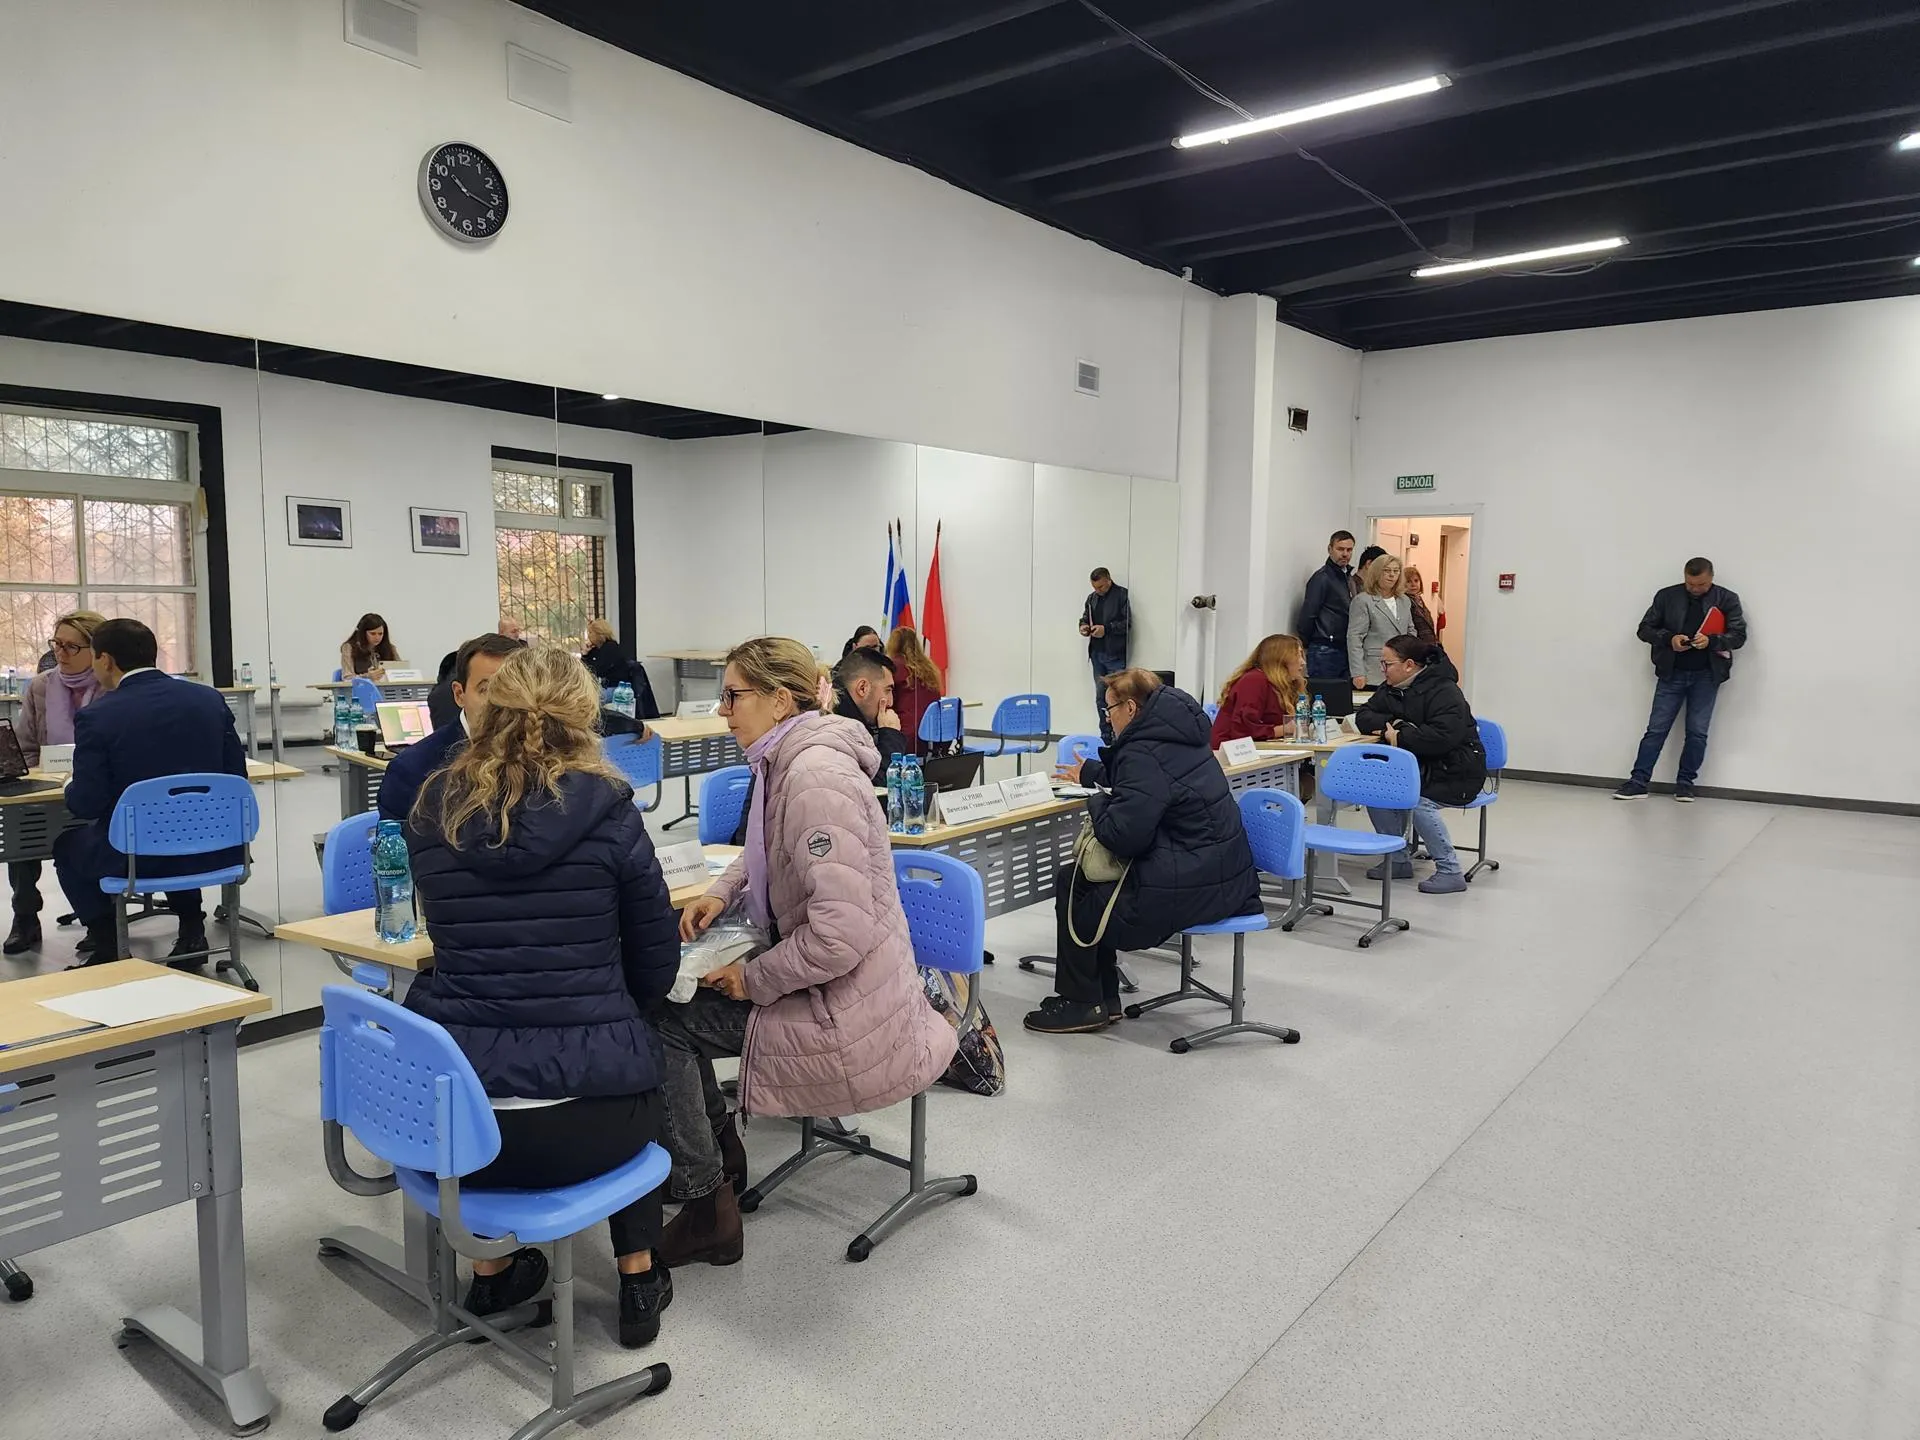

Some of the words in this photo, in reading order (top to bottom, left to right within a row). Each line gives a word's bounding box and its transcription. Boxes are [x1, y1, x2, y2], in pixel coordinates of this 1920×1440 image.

[445, 154, 455, 167] 11
[457, 153, 471, 167] 12
[434, 163, 448, 177] 10
[476, 163, 482, 175] 1
[431, 178, 441, 190] 9
[485, 177, 494, 190] 2
[437, 196, 447, 208] 8
[490, 193, 499, 206] 3
[448, 210, 457, 223] 7
[486, 209, 496, 221] 4
[462, 219, 473, 231] 6
[477, 217, 486, 229] 5
[1399, 476, 1432, 488] ВЫХОД
[663, 862, 705, 876] лександрович
